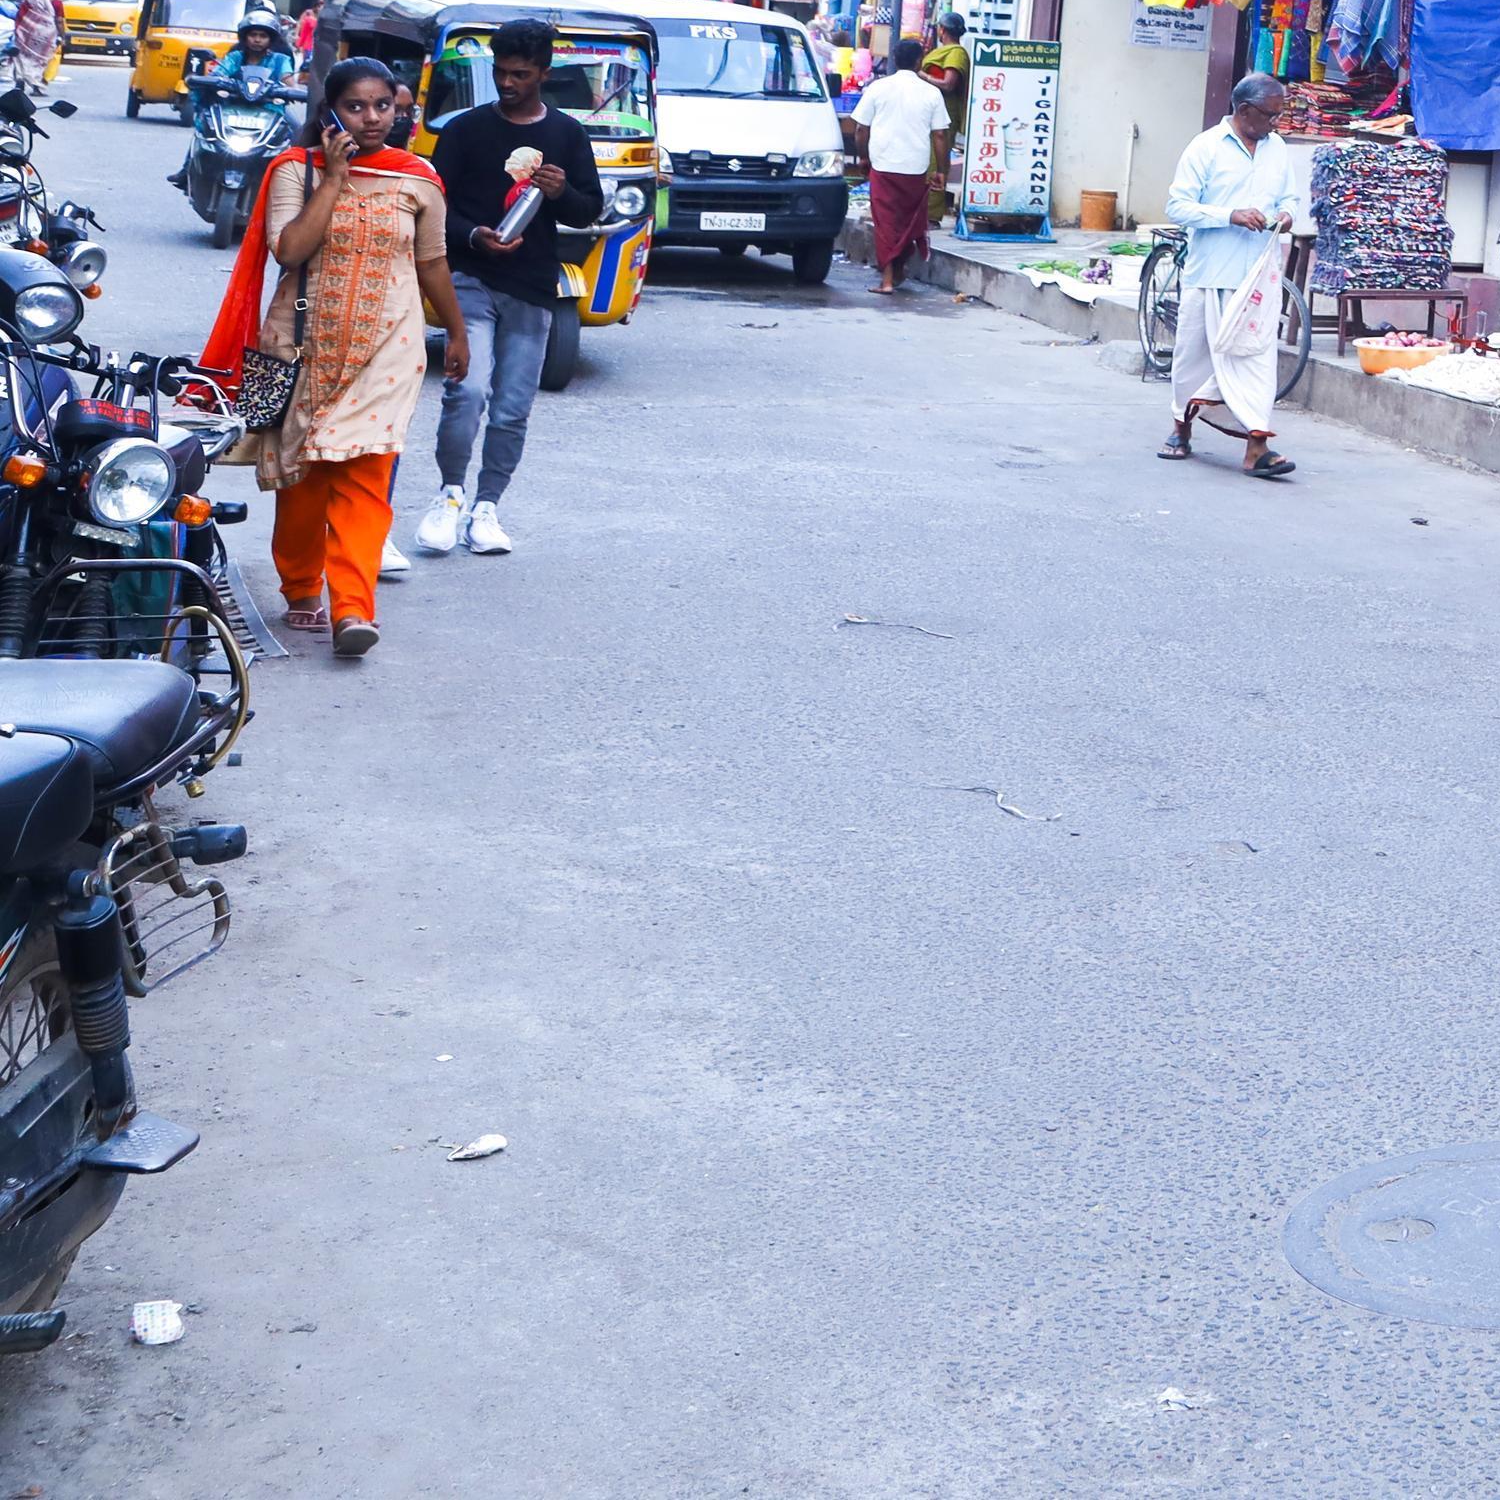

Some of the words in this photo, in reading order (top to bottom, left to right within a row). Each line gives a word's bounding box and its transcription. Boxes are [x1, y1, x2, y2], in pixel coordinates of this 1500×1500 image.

[689, 24, 738, 40] PKS
[1002, 55, 1044, 64] MURUGAN
[1028, 76, 1052, 206] JIGARTHANDA
